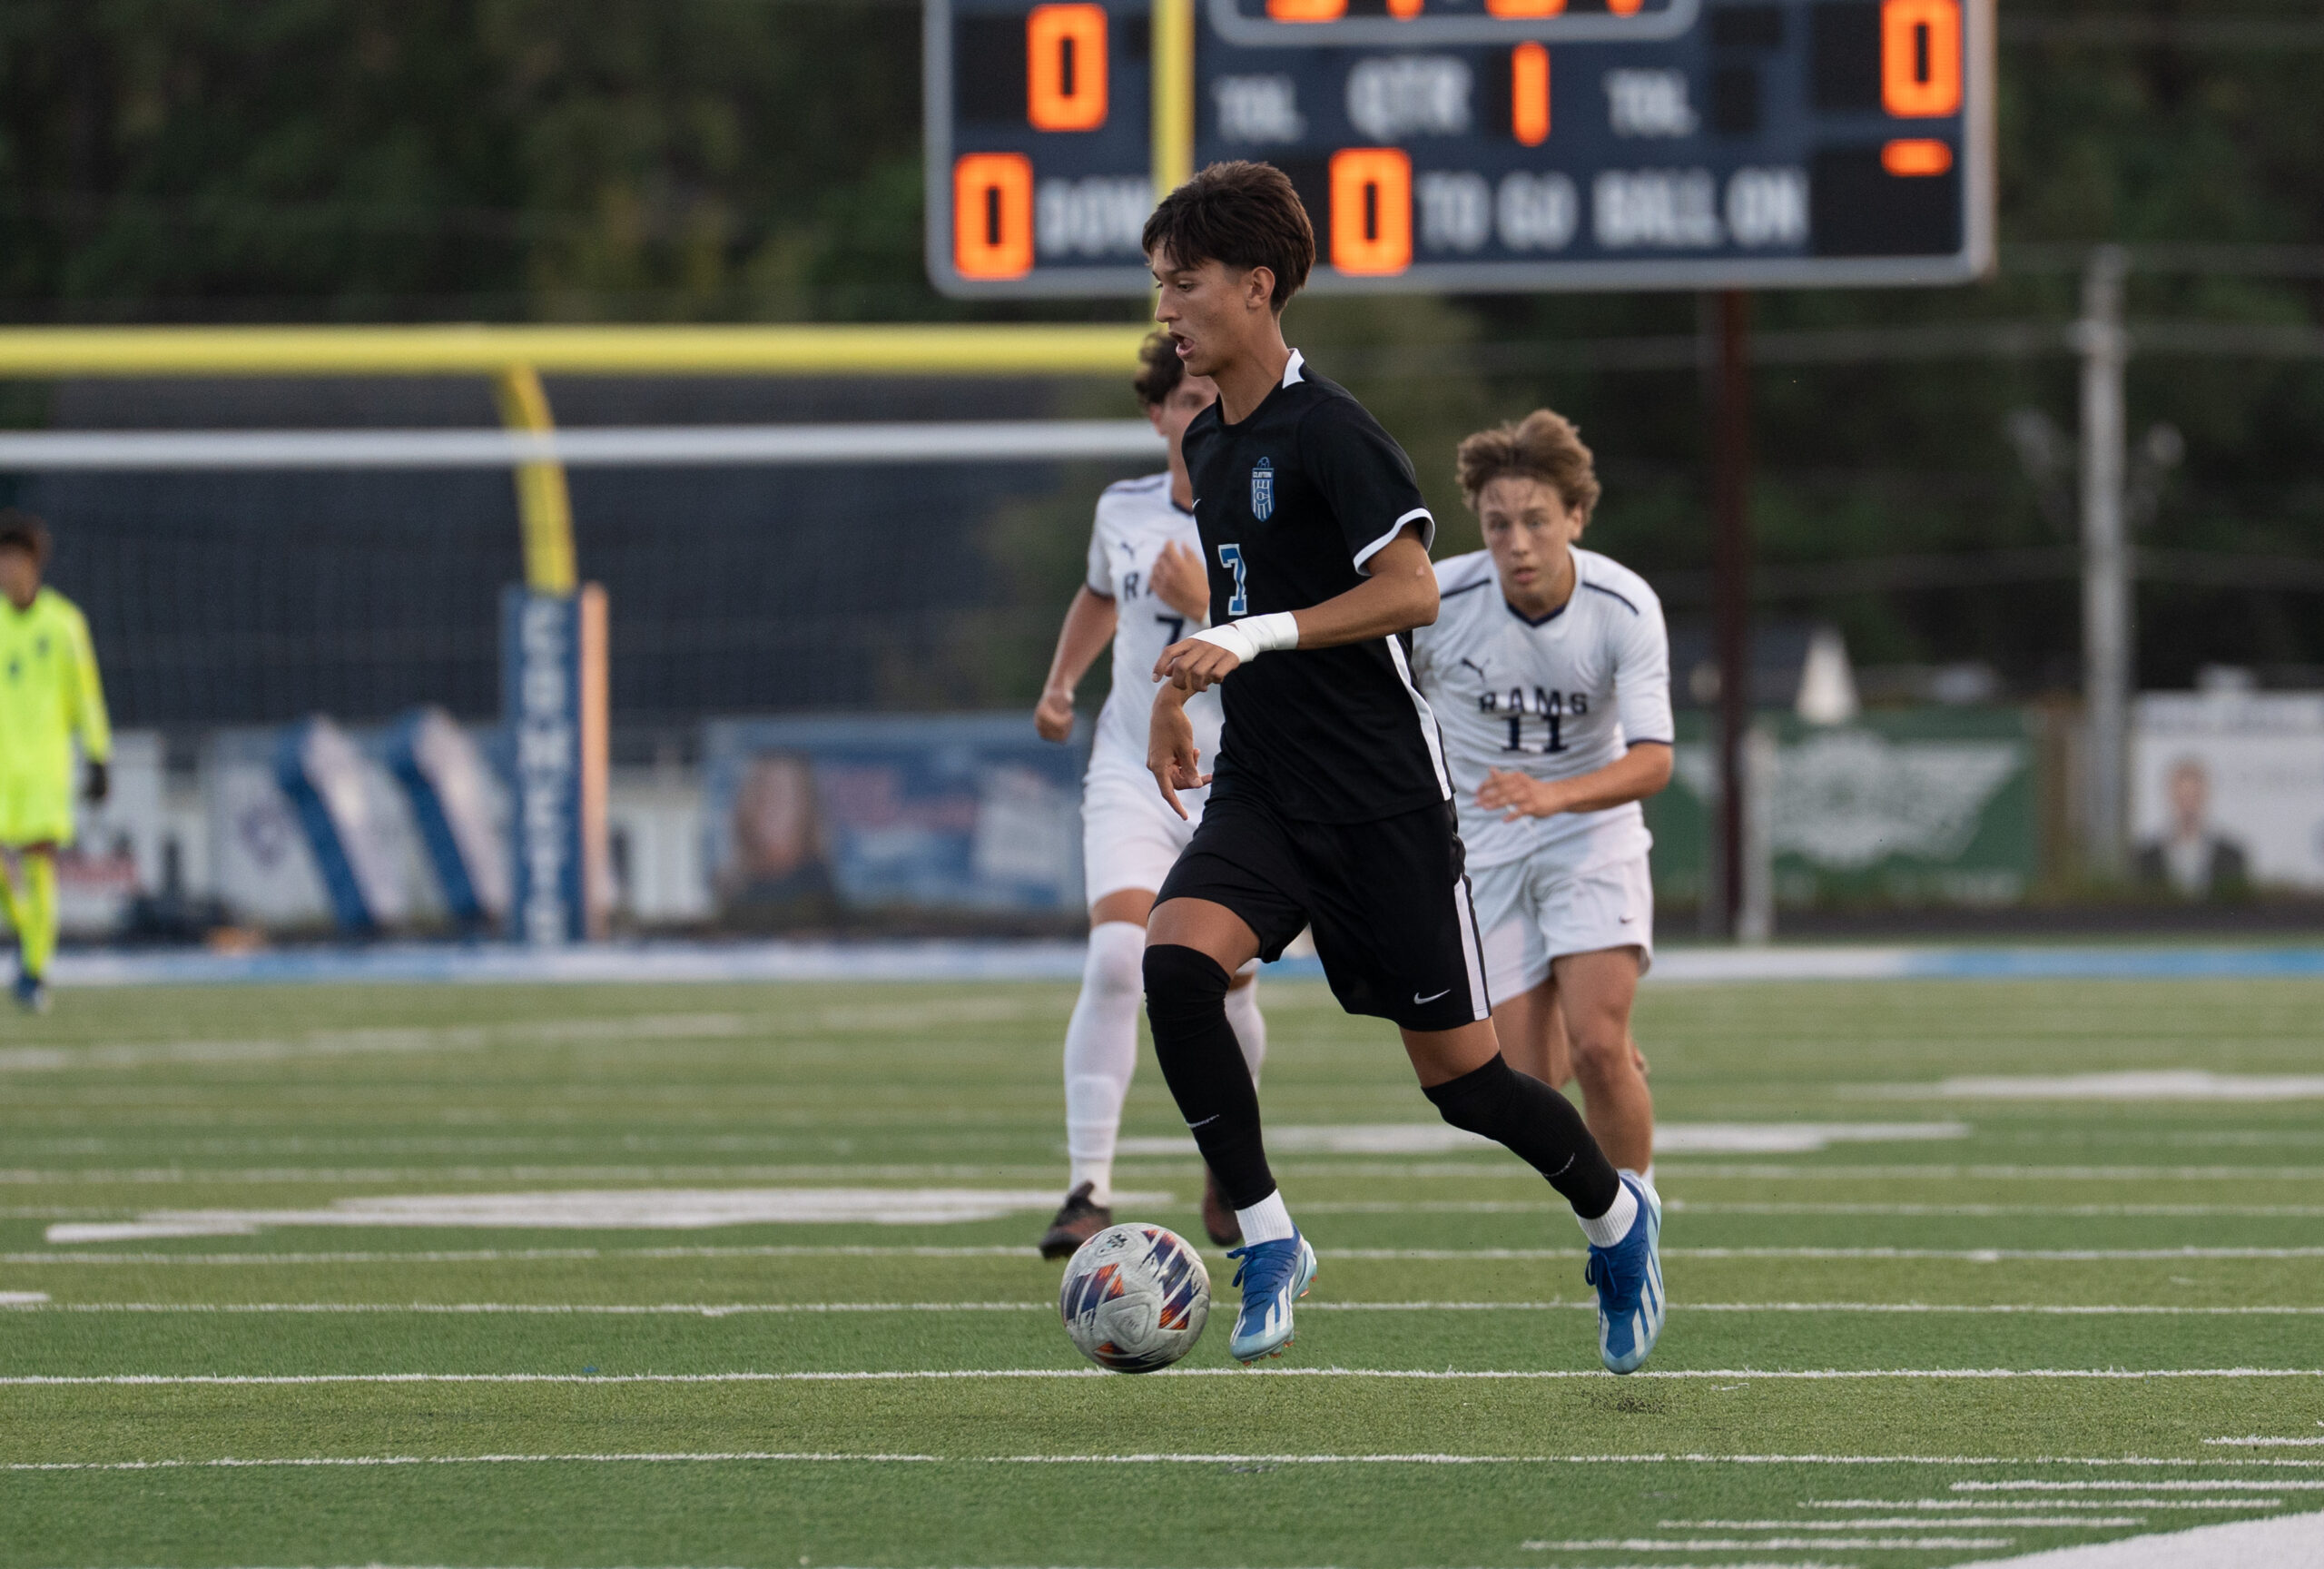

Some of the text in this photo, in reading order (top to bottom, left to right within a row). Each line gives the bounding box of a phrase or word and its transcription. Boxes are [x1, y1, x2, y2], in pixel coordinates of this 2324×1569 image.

[1026, 3, 1108, 133] 0
[1347, 55, 1472, 142] QTR
[1512, 40, 1551, 146] 1
[1880, 0, 1963, 118] 0
[952, 153, 1035, 281] 0
[1037, 179, 1155, 256] DOW
[1328, 147, 1413, 276] 0
[1419, 170, 1579, 250] TO GO
[1593, 166, 1809, 248] BALL ON
[1218, 543, 1248, 616] 7
[1479, 686, 1588, 715] RAMS
[1501, 713, 1568, 753] 11
